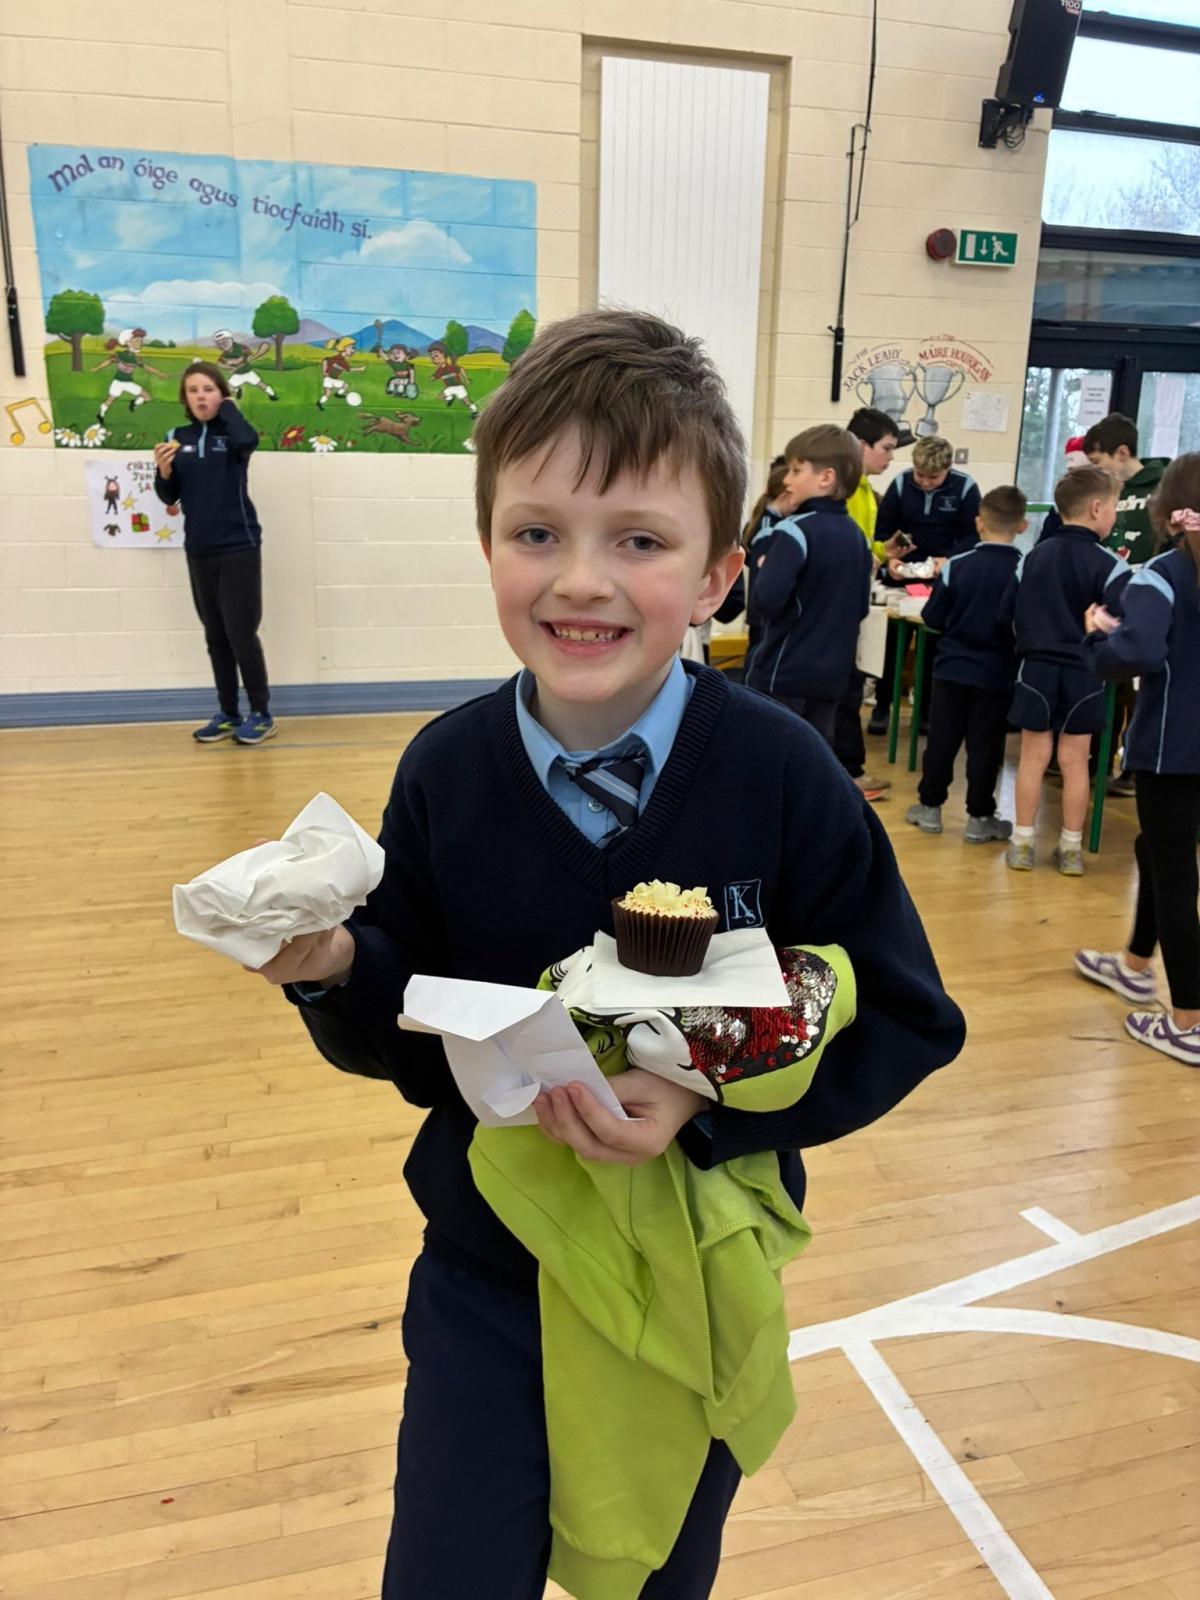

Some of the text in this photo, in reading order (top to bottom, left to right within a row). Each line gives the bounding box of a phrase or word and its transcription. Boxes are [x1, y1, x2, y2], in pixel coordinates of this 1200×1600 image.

[48, 154, 95, 192] Mol
[98, 155, 125, 171] an
[133, 157, 179, 190] óige
[189, 177, 239, 207] agus
[252, 195, 345, 234] tiocfaidh
[843, 363, 868, 392] JACK
[127, 461, 158, 471] CHRIS
[132, 471, 153, 481] JUM
[138, 482, 152, 493] SA
